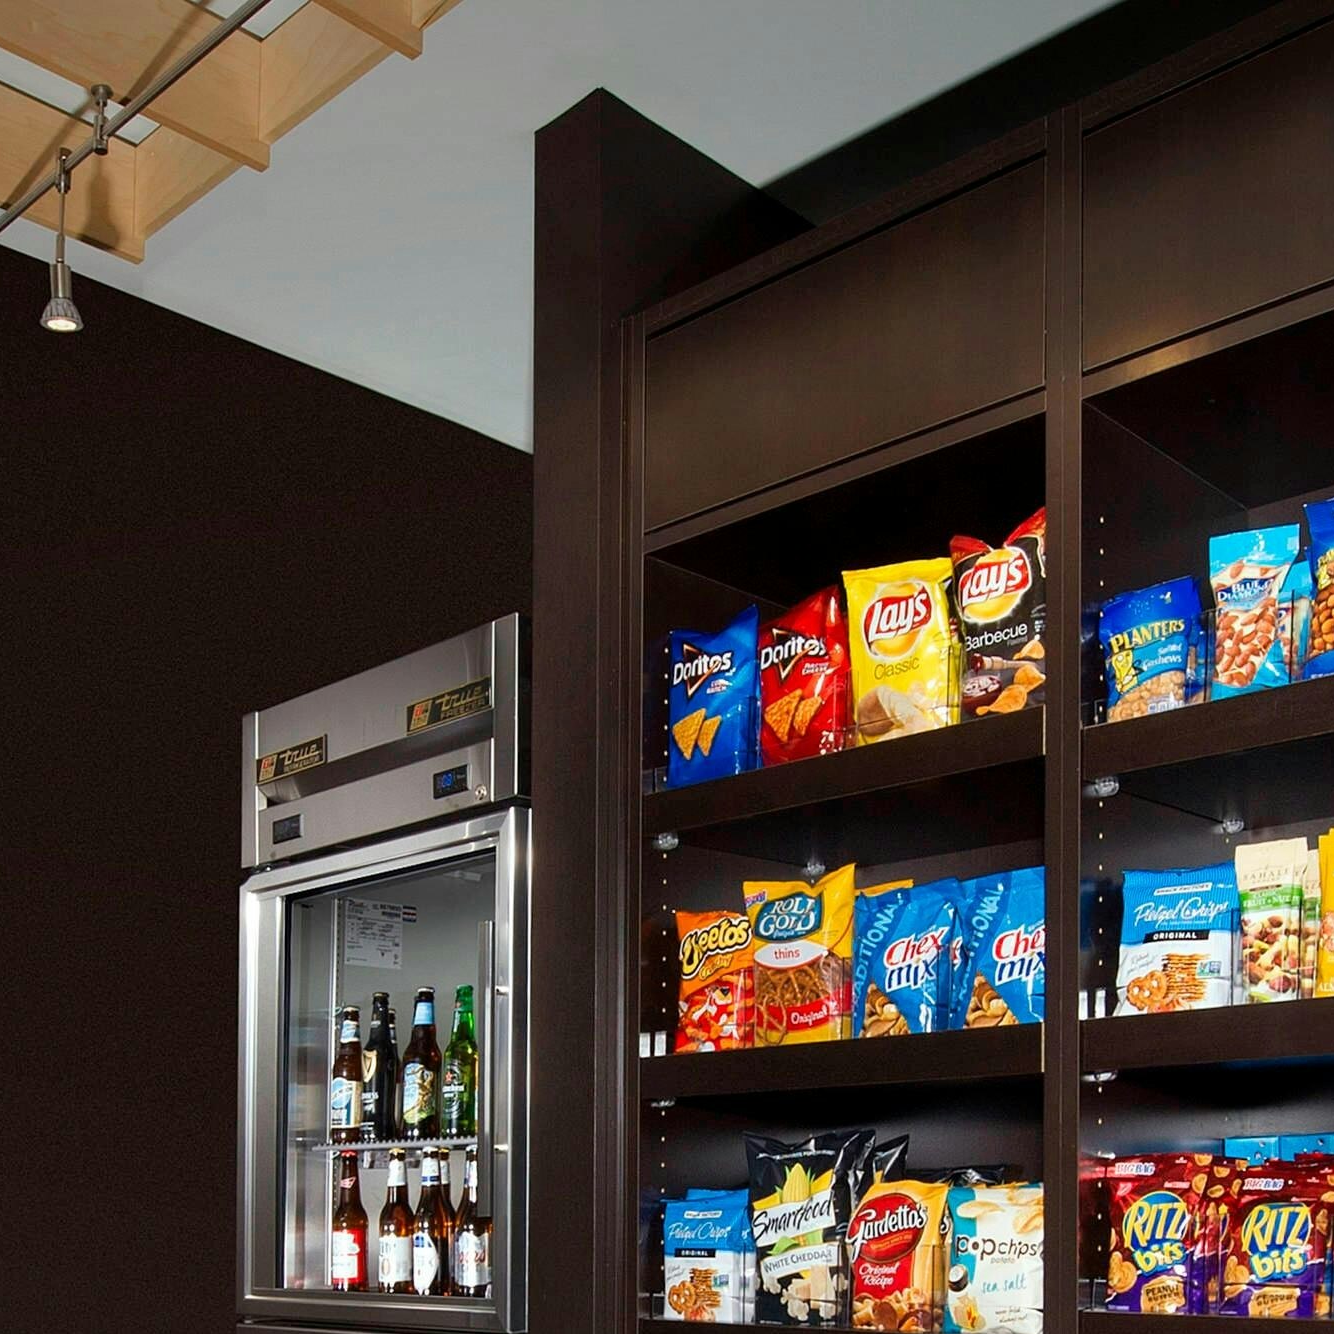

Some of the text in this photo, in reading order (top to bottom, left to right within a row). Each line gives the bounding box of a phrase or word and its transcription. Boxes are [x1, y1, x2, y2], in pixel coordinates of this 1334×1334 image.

[962, 556, 1023, 608] Lay's
[868, 590, 932, 642] Lay's
[964, 620, 1028, 652] Barbecue
[1111, 619, 1185, 654] PLANTERS
[673, 649, 732, 685] Doritos
[761, 634, 827, 670] Doritos
[1142, 653, 1182, 671] Cashews
[874, 655, 920, 681] Classic
[759, 910, 816, 939] GOLD
[1134, 897, 1229, 928] Pretzel Crisps
[682, 918, 751, 976] Cheetos
[887, 928, 945, 967] Chex
[1153, 931, 1197, 940] ORIGINAL
[774, 947, 800, 960] thins
[791, 1008, 828, 1026] Original
[754, 1192, 834, 1241] Smartfood
[1124, 1201, 1188, 1249] RITZ
[1242, 1205, 1310, 1252] RITZ
[846, 1203, 928, 1263] Gardetto's
[764, 1256, 789, 1273] WHITE
[859, 1262, 900, 1278] Original
[1133, 1242, 1184, 1272] bits
[1250, 1248, 1305, 1279] bits
[863, 1274, 894, 1289] Recipe
[980, 1275, 1027, 1294] sea salt
